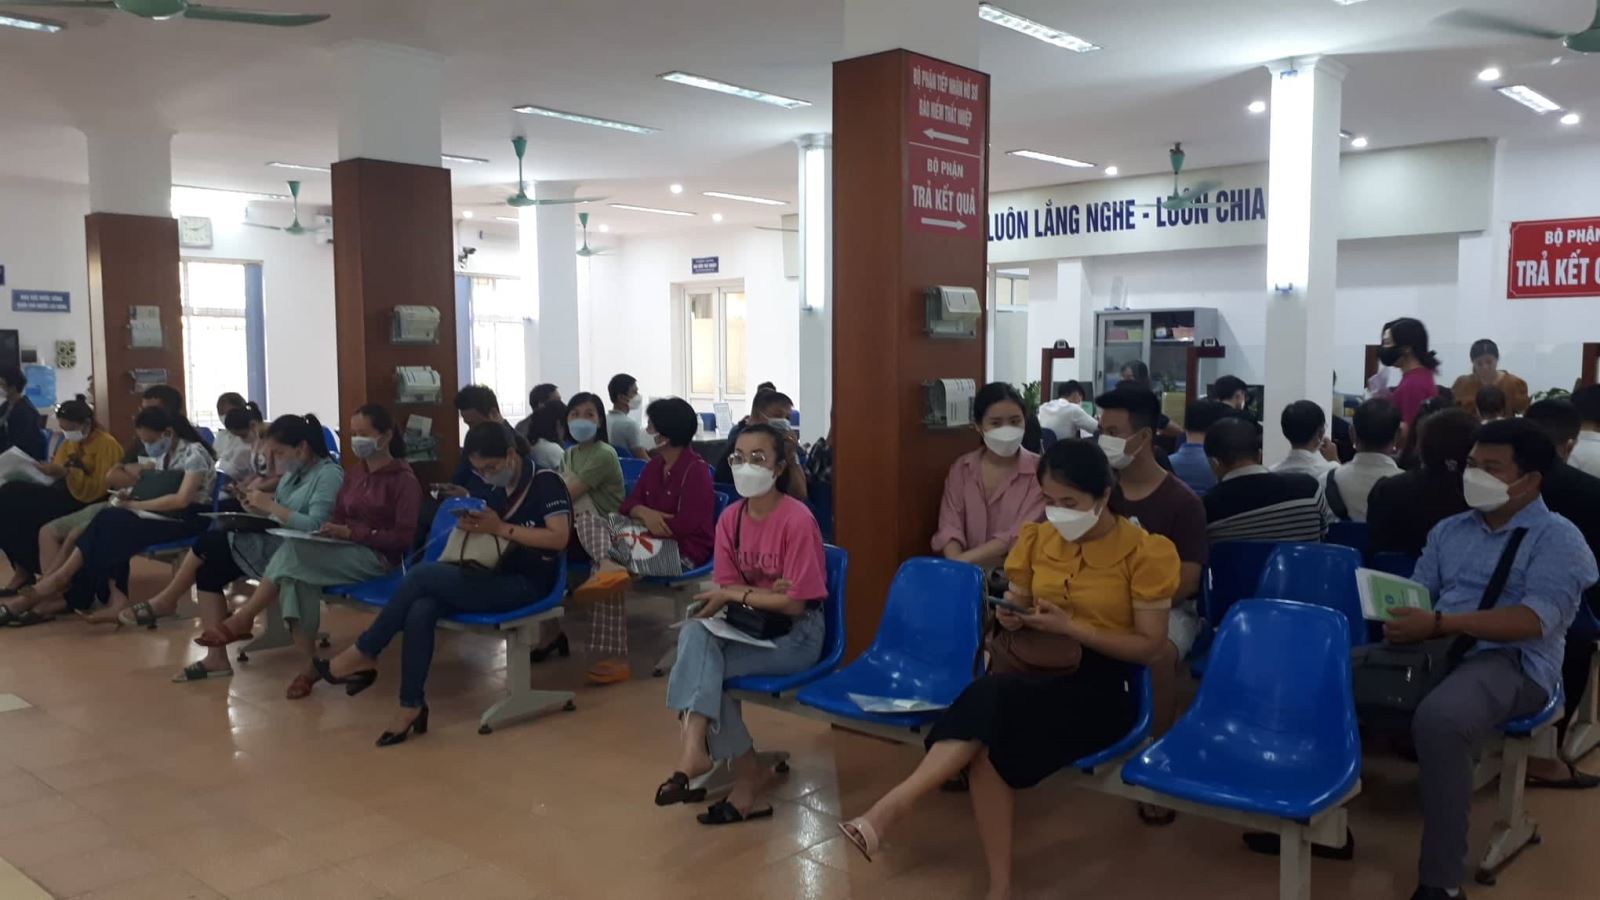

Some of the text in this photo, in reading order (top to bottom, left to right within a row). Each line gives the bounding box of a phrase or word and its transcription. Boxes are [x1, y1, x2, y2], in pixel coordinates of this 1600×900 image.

[927, 157, 964, 180] BỘ PHẬN
[912, 180, 976, 217] TRẢ KẾT QUẢ
[987, 206, 1028, 241] LUÔN
[1034, 199, 1080, 238] LẮNG
[1086, 200, 1136, 233] NGHE
[1216, 187, 1266, 223] CHIA
[1544, 227, 1563, 247] BỘ
[1516, 250, 1550, 287] TRẢ
[1555, 249, 1590, 286] KẾT
